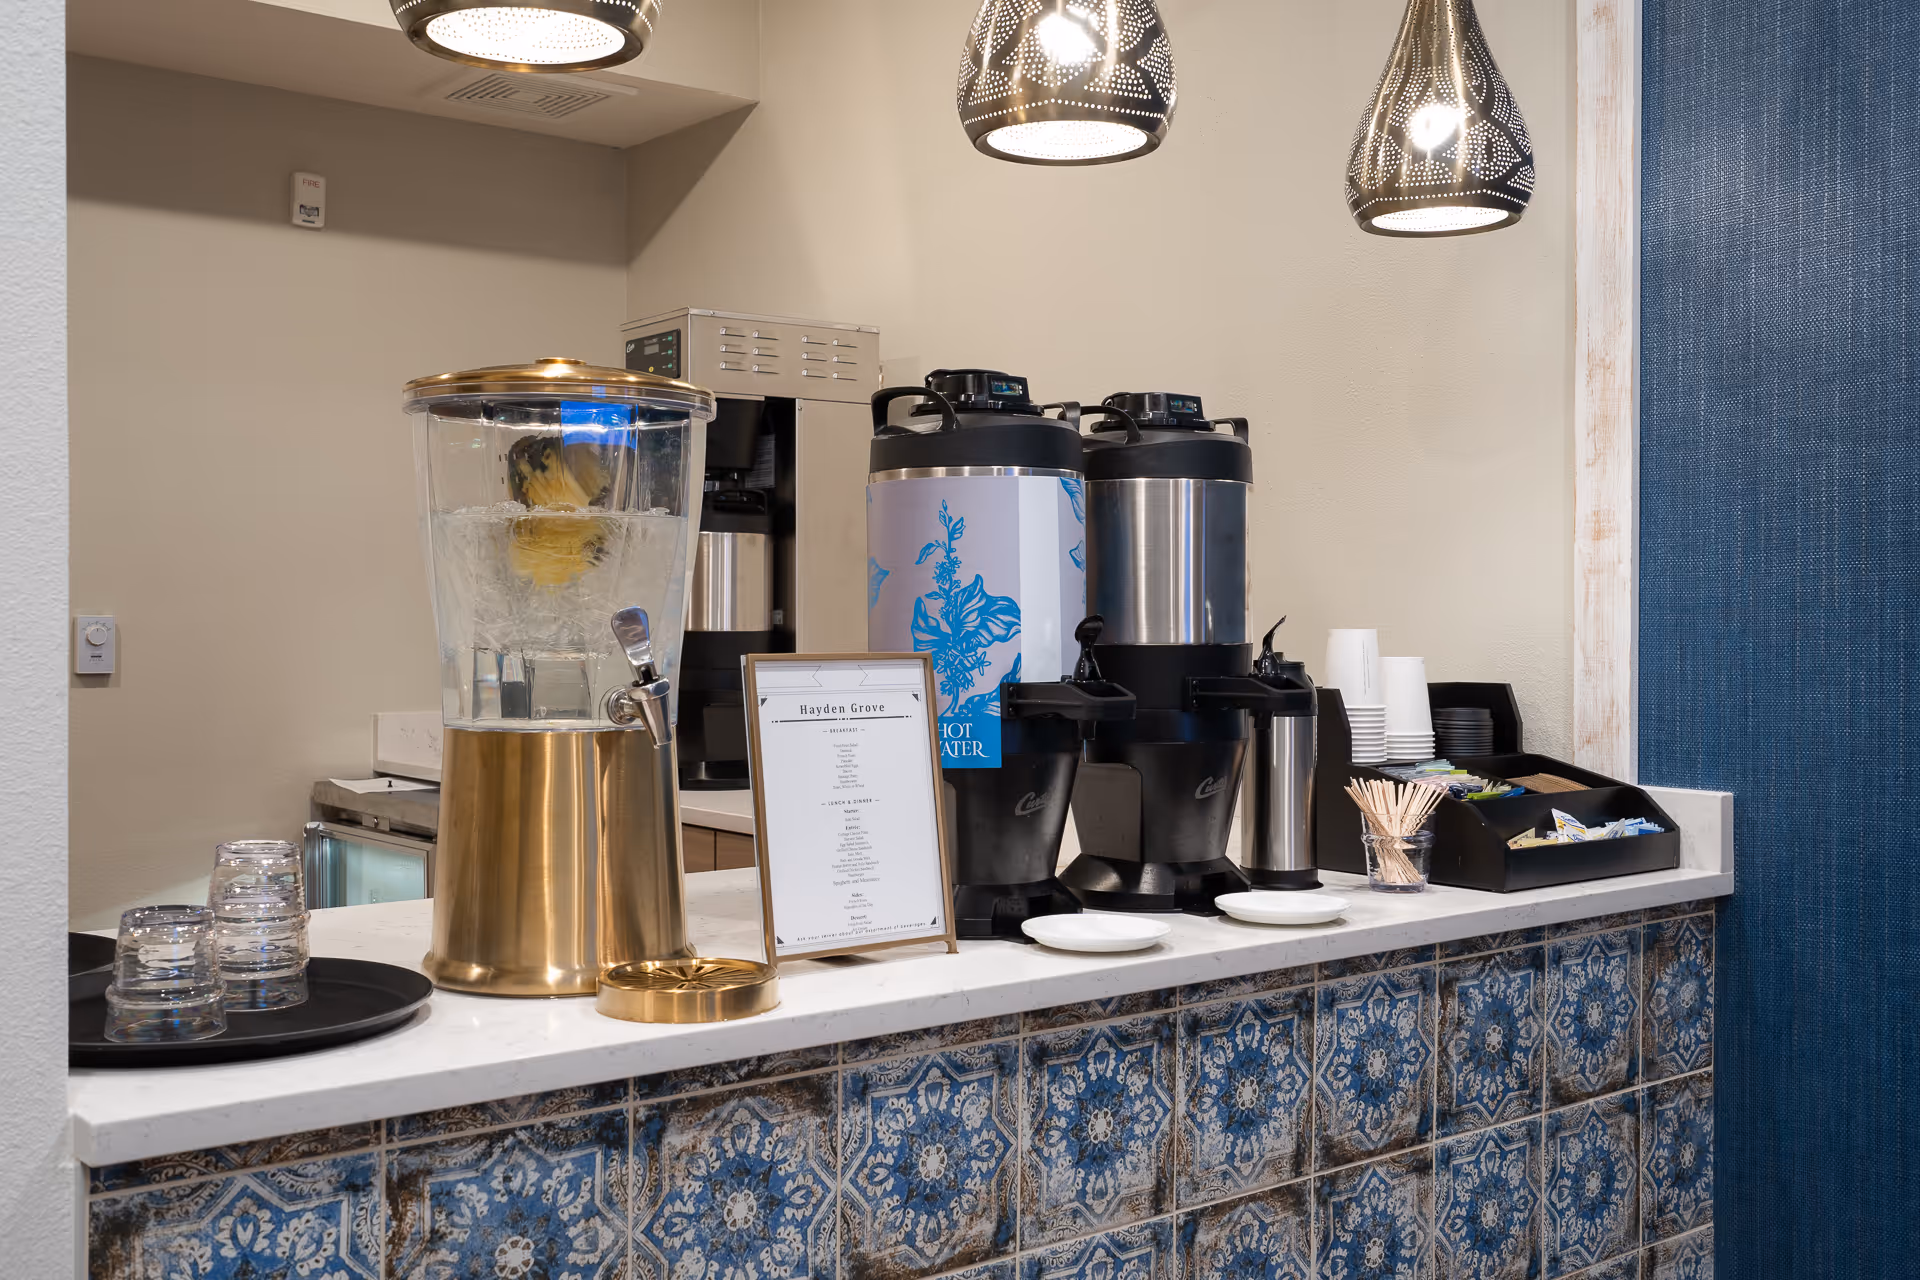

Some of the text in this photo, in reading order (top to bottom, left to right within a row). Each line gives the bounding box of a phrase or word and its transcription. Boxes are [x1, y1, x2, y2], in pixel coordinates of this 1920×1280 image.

[303, 179, 320, 188] FIRE
[800, 703, 885, 716] Hayden Grove
[938, 722, 973, 738] HOT
[940, 740, 990, 758] ATER
